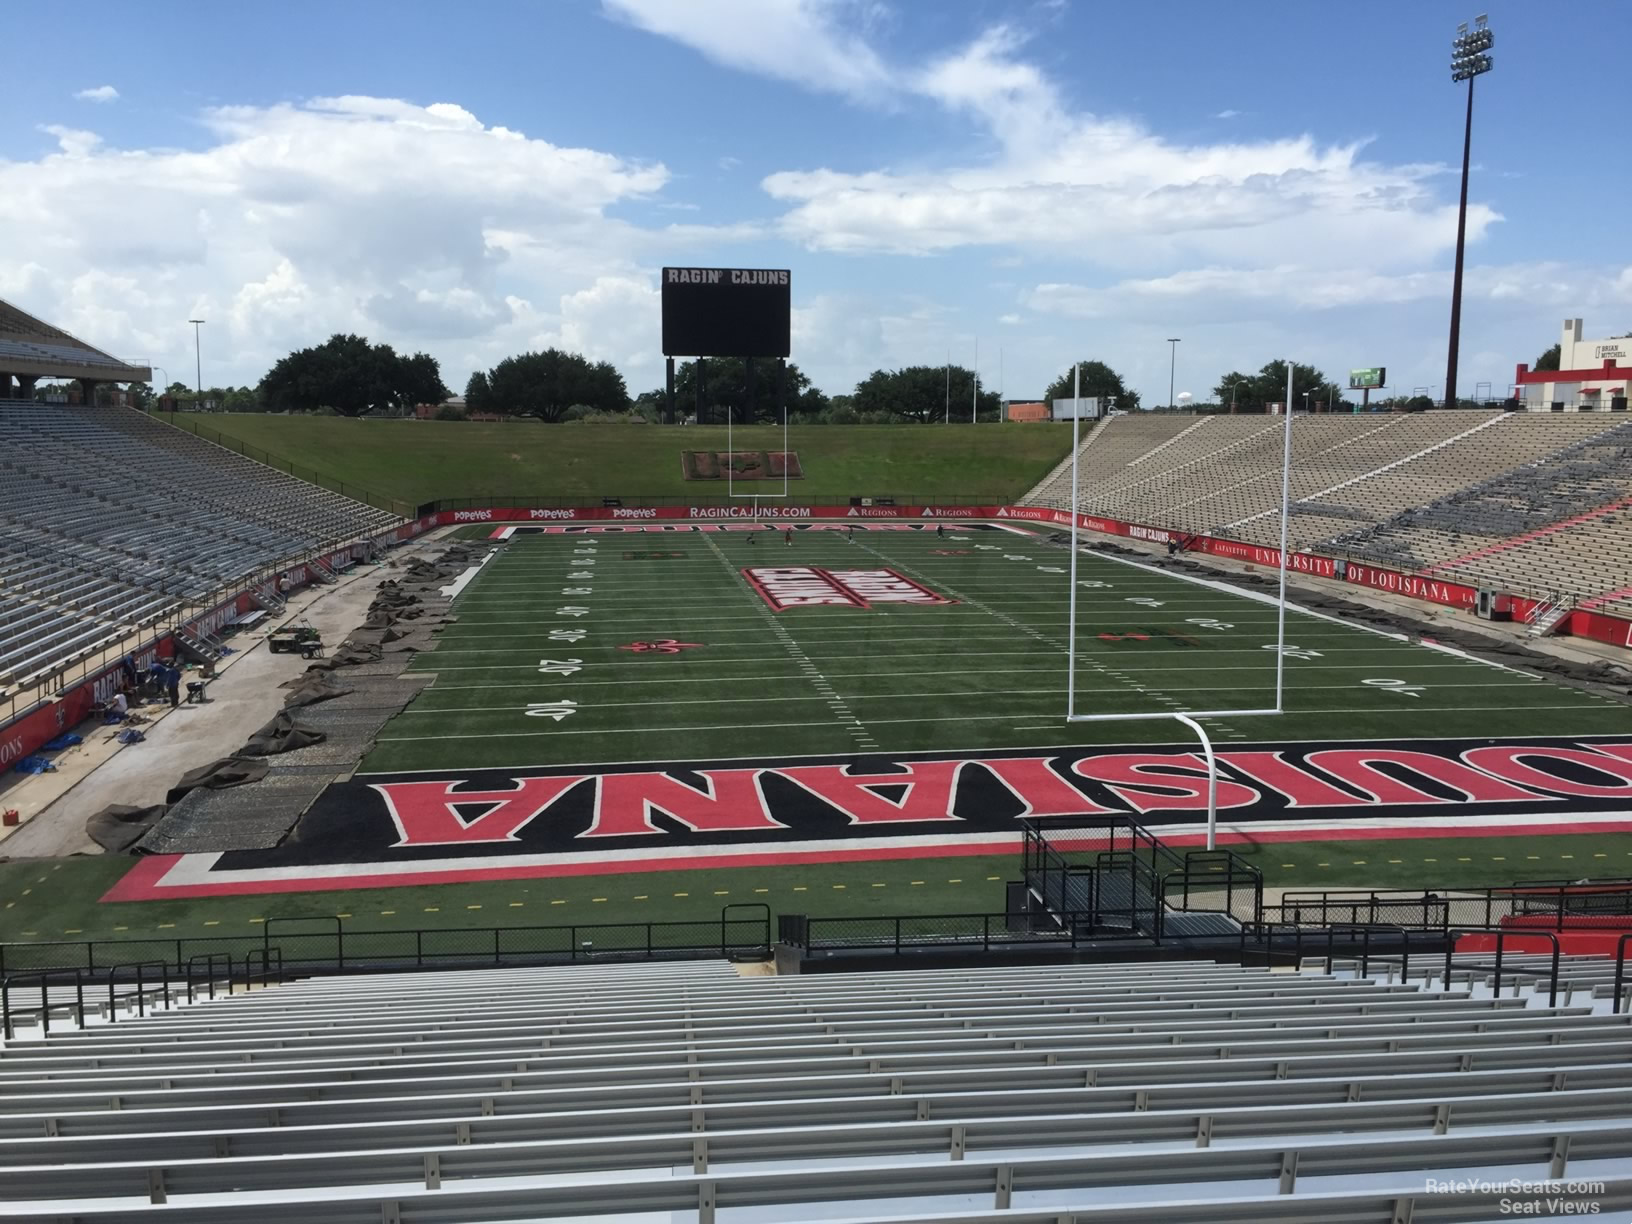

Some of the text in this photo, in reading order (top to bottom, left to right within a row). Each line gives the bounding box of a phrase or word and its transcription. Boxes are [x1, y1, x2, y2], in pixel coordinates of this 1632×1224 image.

[731, 270, 788, 285] CAJUNS
[1147, 528, 1169, 543] CAJUNS
[1215, 543, 1247, 556] LAFAYETTE
[1349, 565, 1365, 582] OF
[1370, 570, 1450, 601] LOUISIANA
[537, 658, 583, 673] 20
[524, 699, 578, 717] 10
